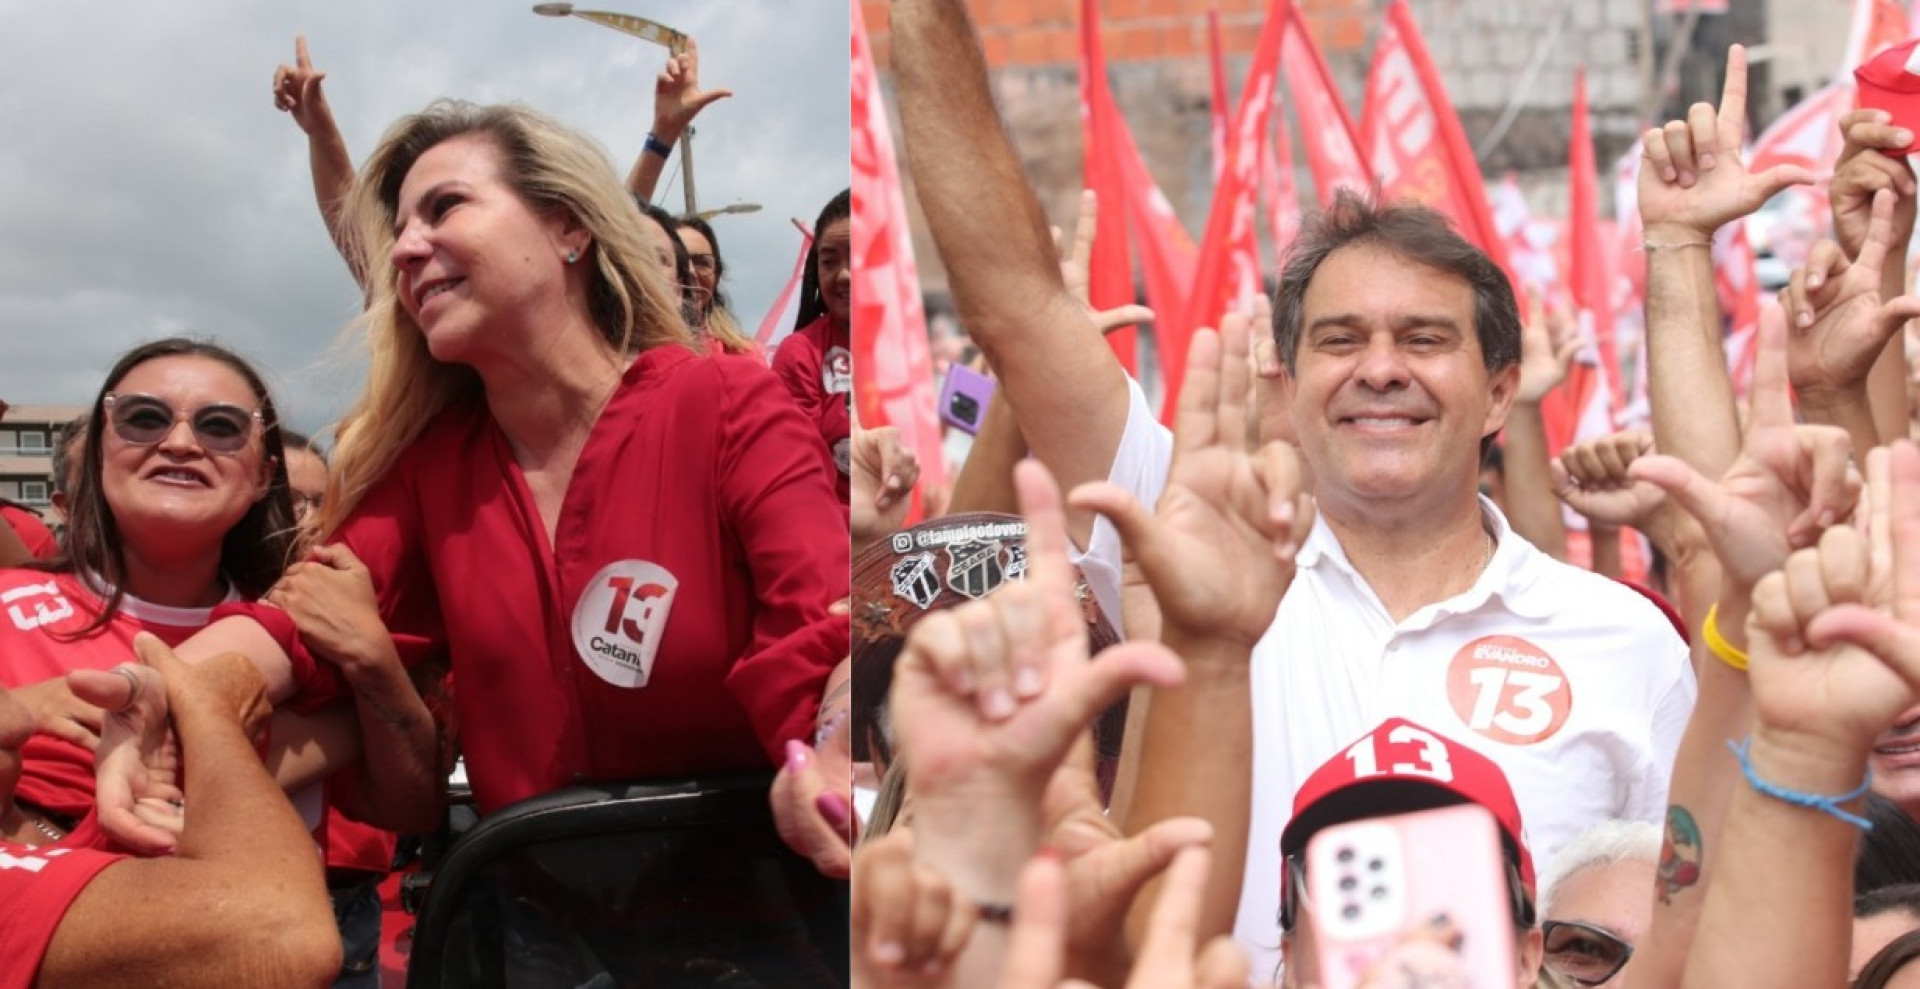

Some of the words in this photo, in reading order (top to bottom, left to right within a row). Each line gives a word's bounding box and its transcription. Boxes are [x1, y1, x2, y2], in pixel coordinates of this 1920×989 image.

[1, 580, 74, 631] 13
[605, 577, 668, 645] 13
[1468, 667, 1562, 736] 13
[1345, 725, 1454, 783] 13
